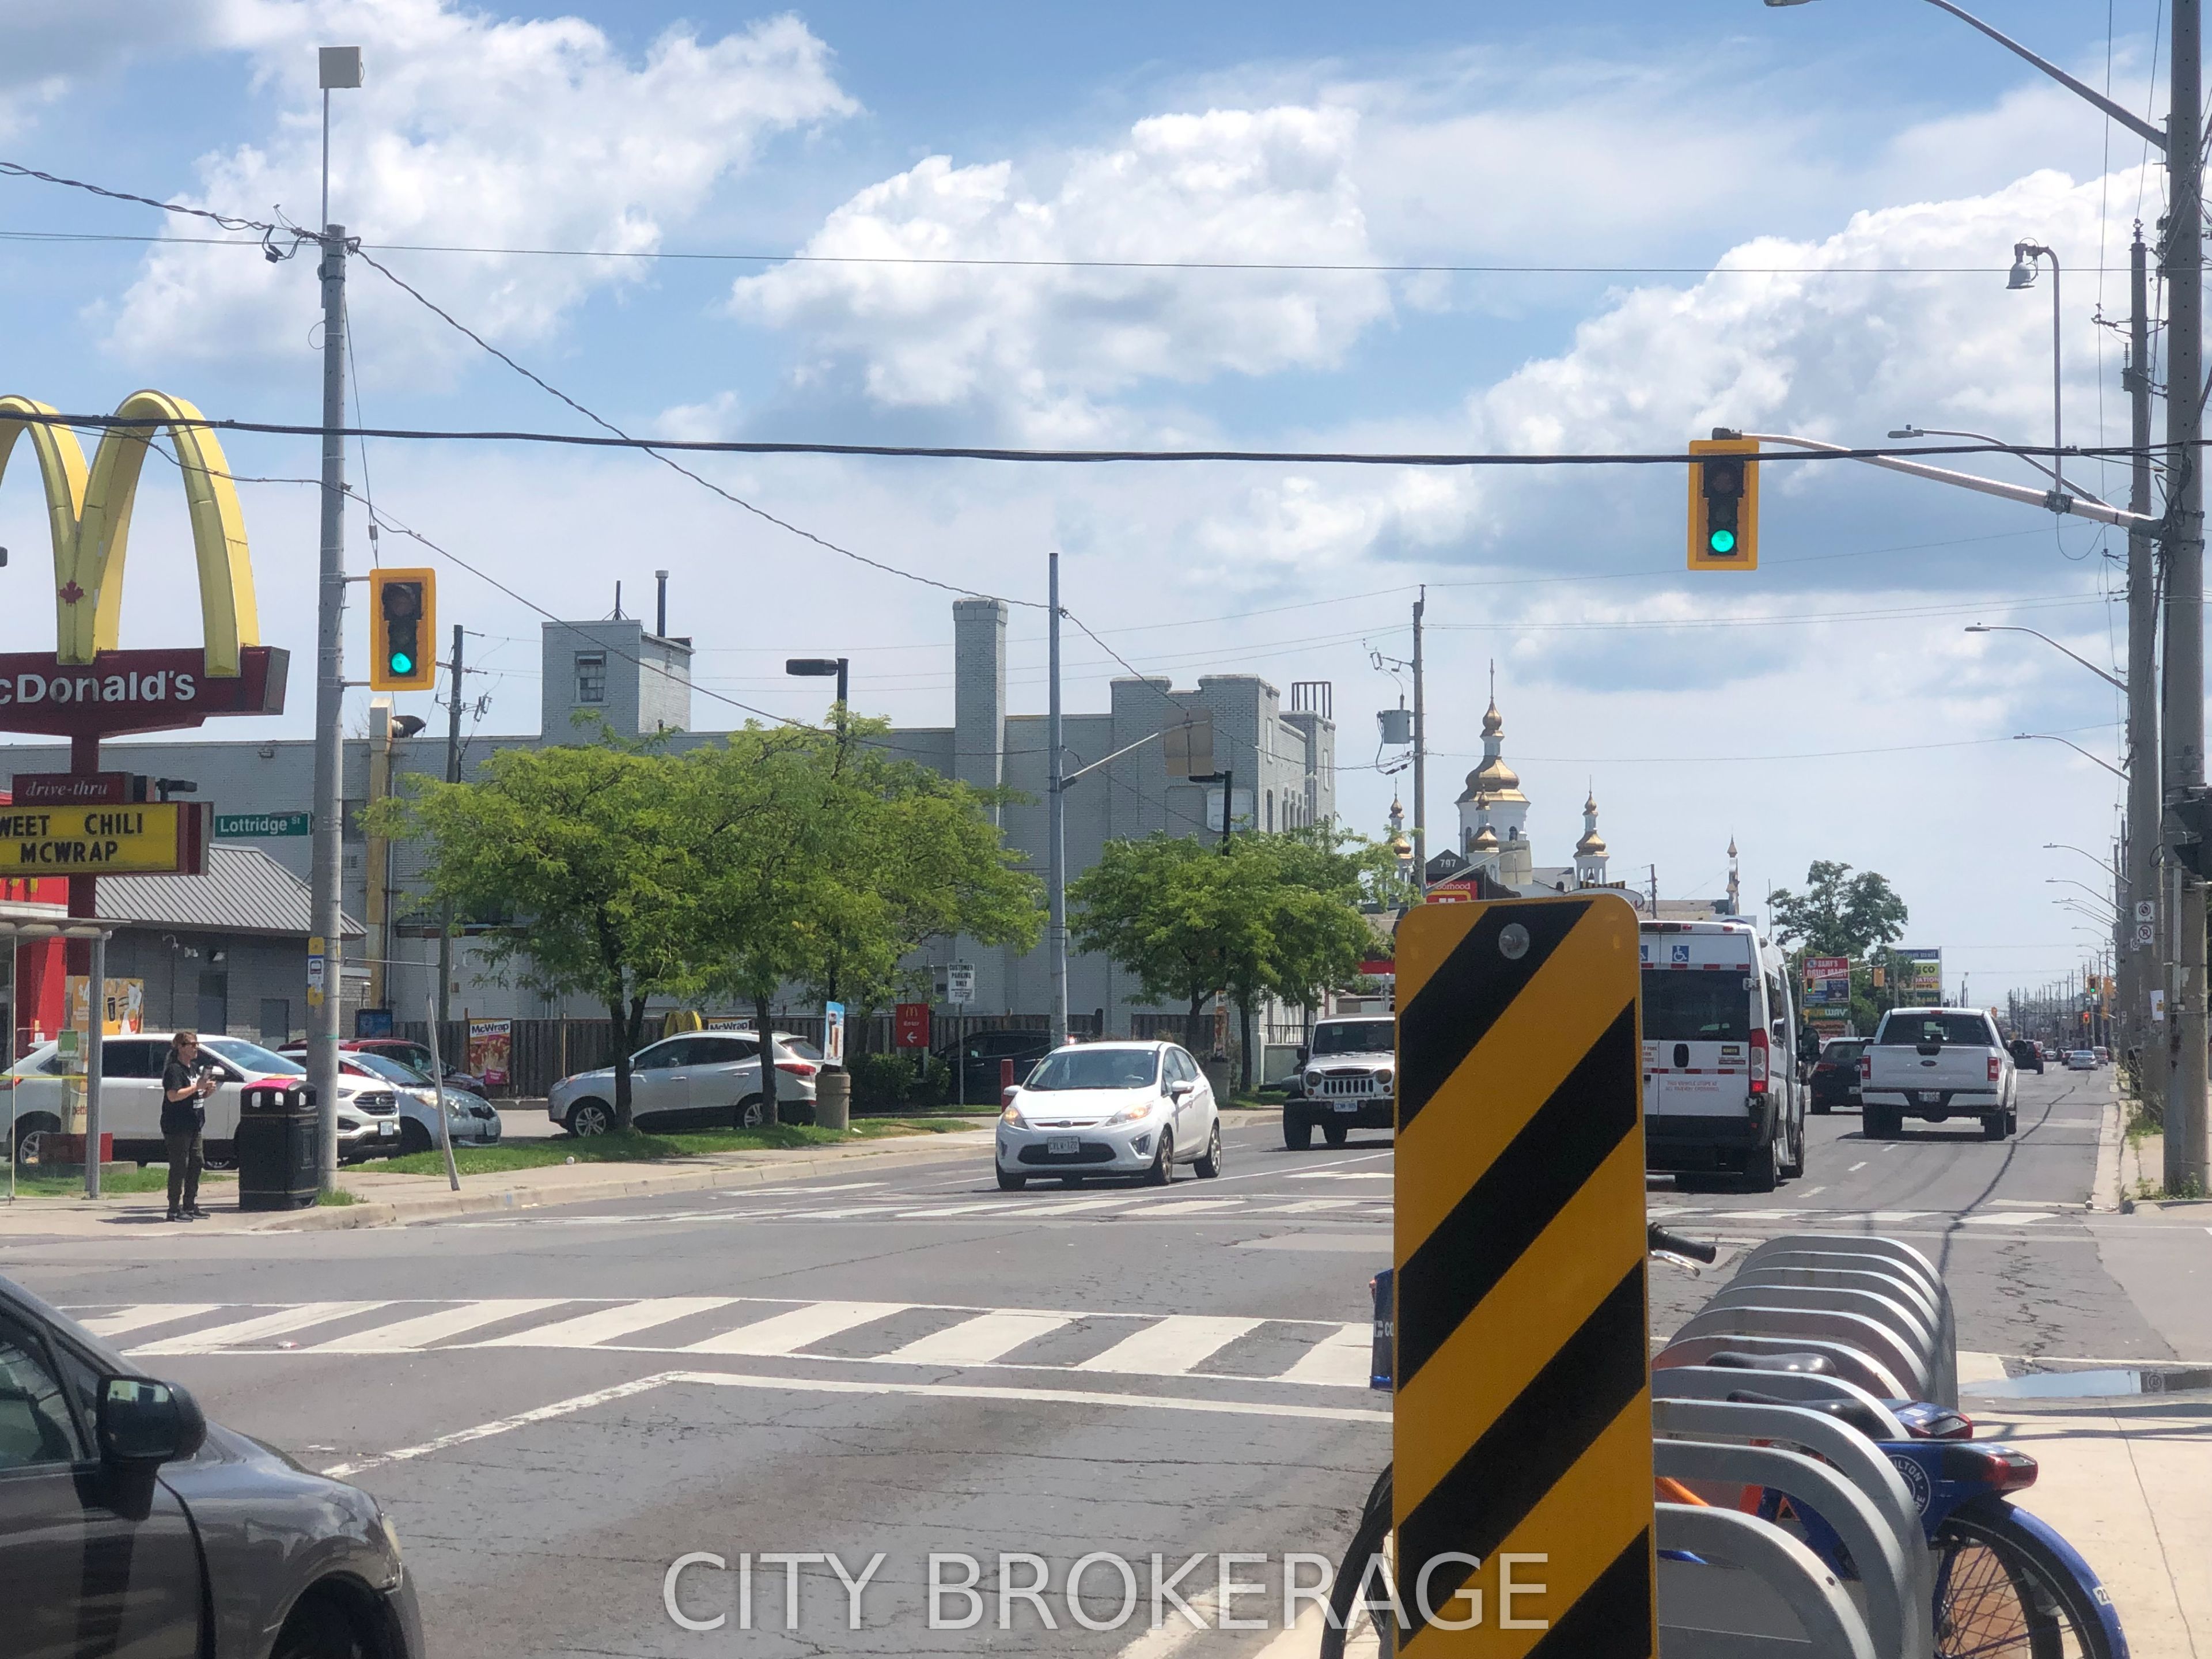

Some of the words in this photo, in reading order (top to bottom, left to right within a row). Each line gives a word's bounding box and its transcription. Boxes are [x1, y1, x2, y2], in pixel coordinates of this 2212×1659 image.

[25, 781, 108, 797] drive-thru
[0, 815, 50, 836] WEET
[84, 813, 143, 835] CHILI
[220, 817, 287, 835] Lottridge
[291, 816, 301, 824] St
[20, 841, 118, 863] MCWRAP
[472, 1024, 509, 1034] McWrap
[710, 1022, 748, 1031] McWrap
